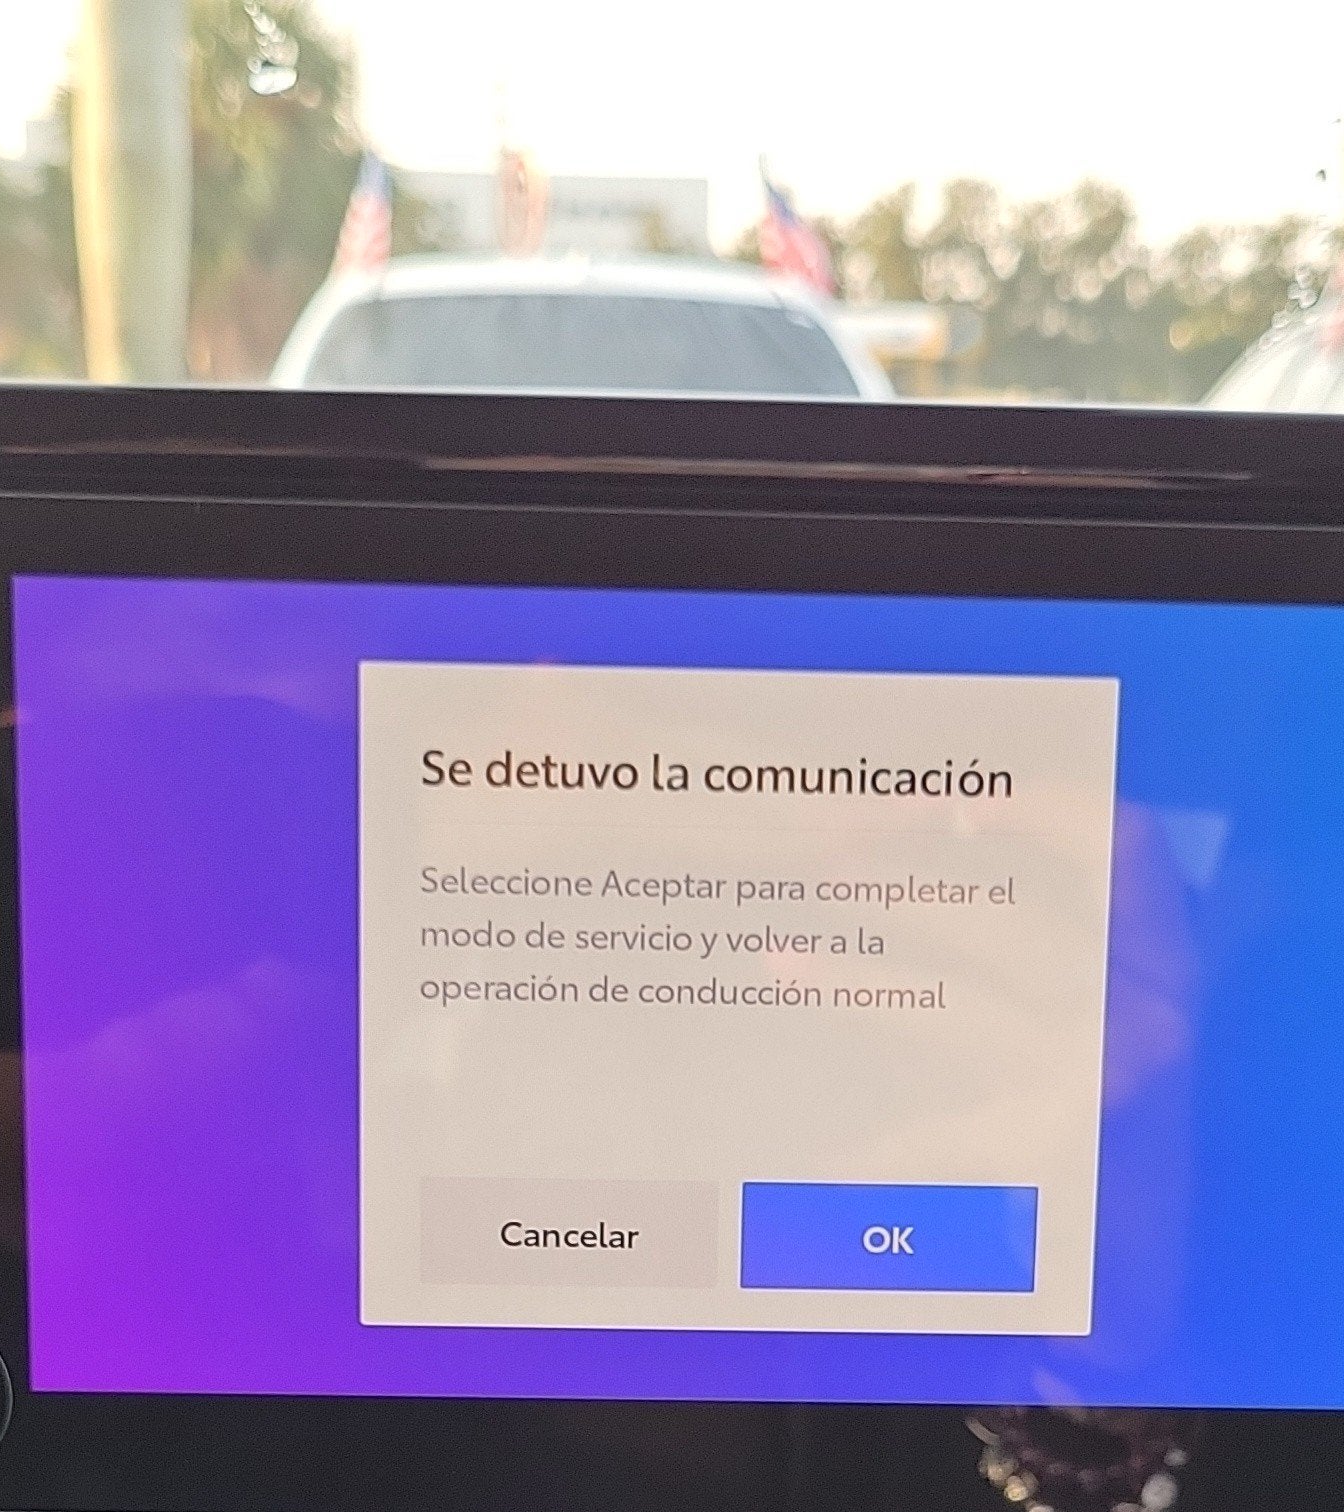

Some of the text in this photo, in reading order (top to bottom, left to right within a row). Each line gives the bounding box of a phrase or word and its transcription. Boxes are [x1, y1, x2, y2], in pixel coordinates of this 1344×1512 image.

[422, 750, 1012, 798] Se detuvo la comunicación
[420, 866, 1016, 910] Seleccione Aceptar para completar el
[421, 920, 884, 959] modo de servicio y volver a la
[420, 974, 946, 1009] operación de conducción normal
[500, 1221, 639, 1249] Cancelar
[862, 1226, 915, 1254] OK
